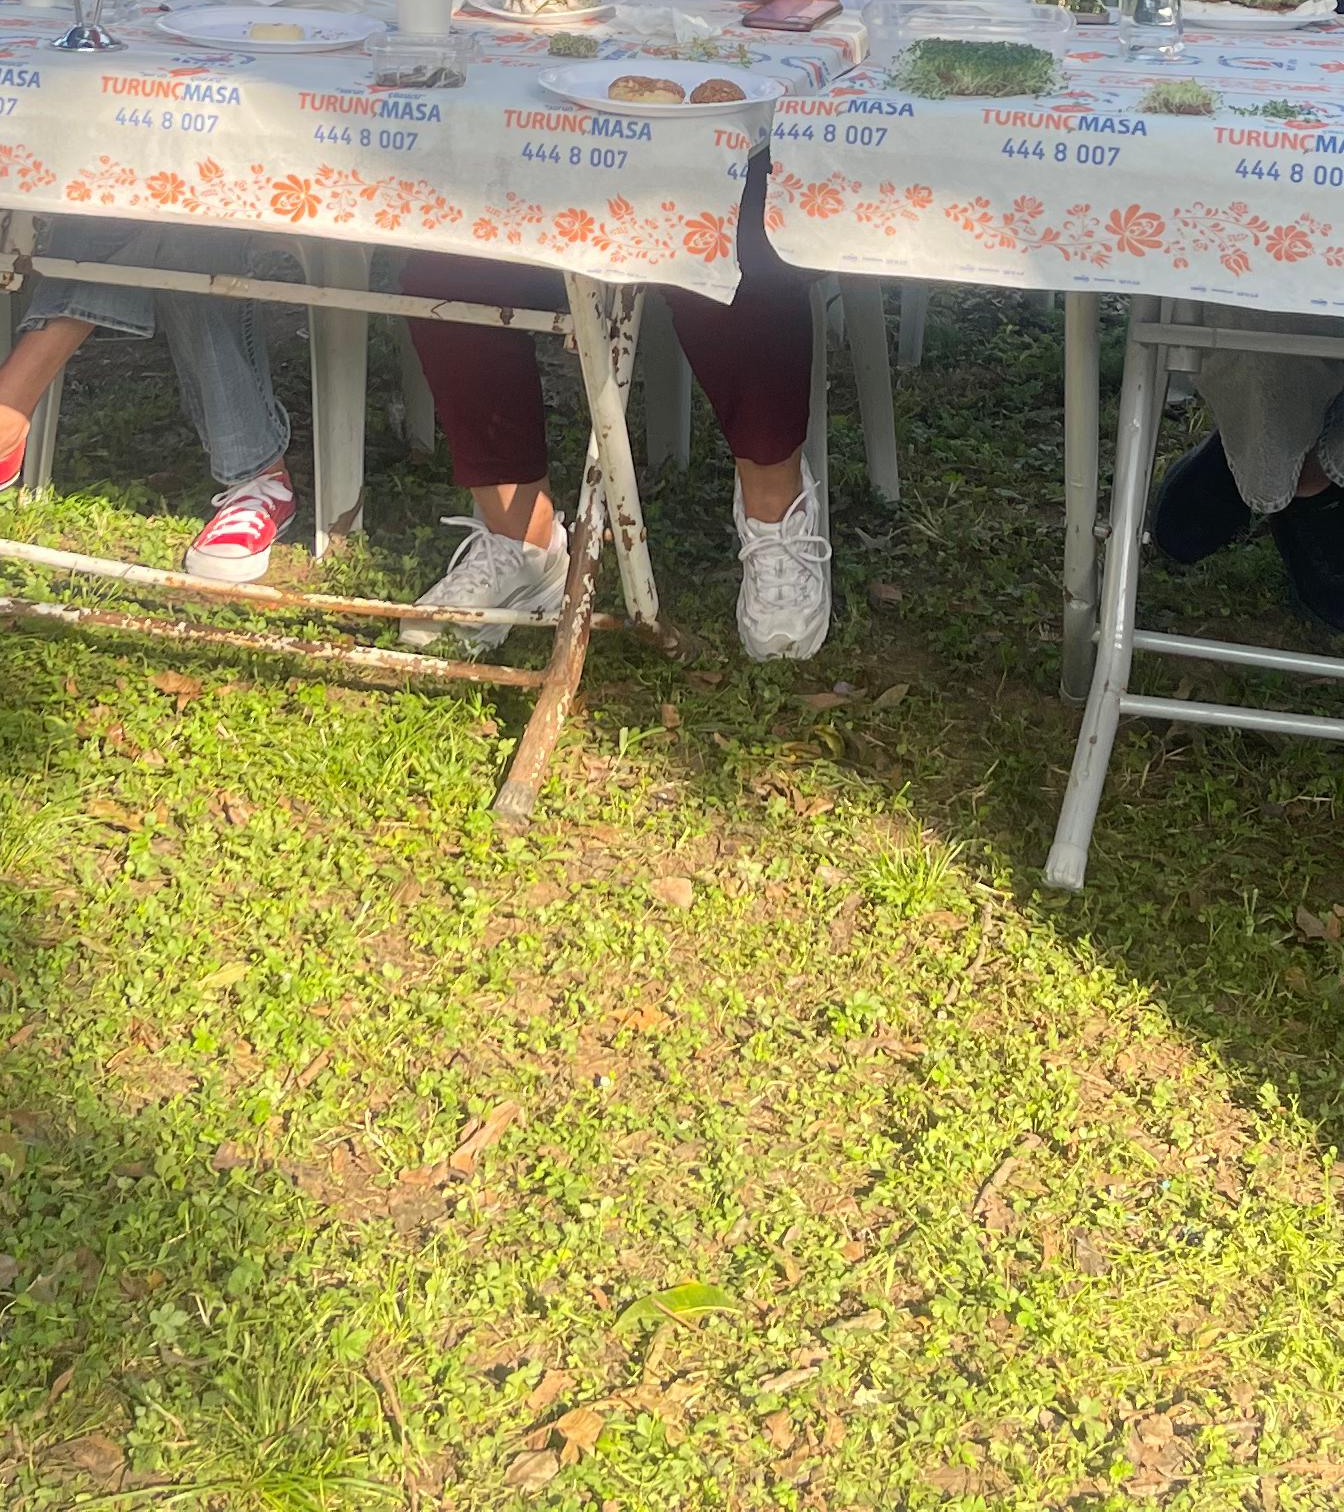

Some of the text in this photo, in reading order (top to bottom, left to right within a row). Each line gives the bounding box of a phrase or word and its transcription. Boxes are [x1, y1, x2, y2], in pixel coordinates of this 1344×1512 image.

[100, 75, 241, 106] TURUNÇMASA
[115, 107, 220, 134] 444 8 007
[297, 91, 441, 123] TURUNÇMASA
[503, 108, 653, 142] TURUNÇMASA
[773, 122, 889, 147] 444 8 007
[981, 107, 1148, 137] TURUNÇMASA
[313, 125, 419, 152] 444 8 007
[1001, 137, 1122, 167] 444 8 007
[520, 142, 629, 170] 444 8 007
[1235, 158, 1281, 181] 444
[1290, 162, 1304, 184] 8
